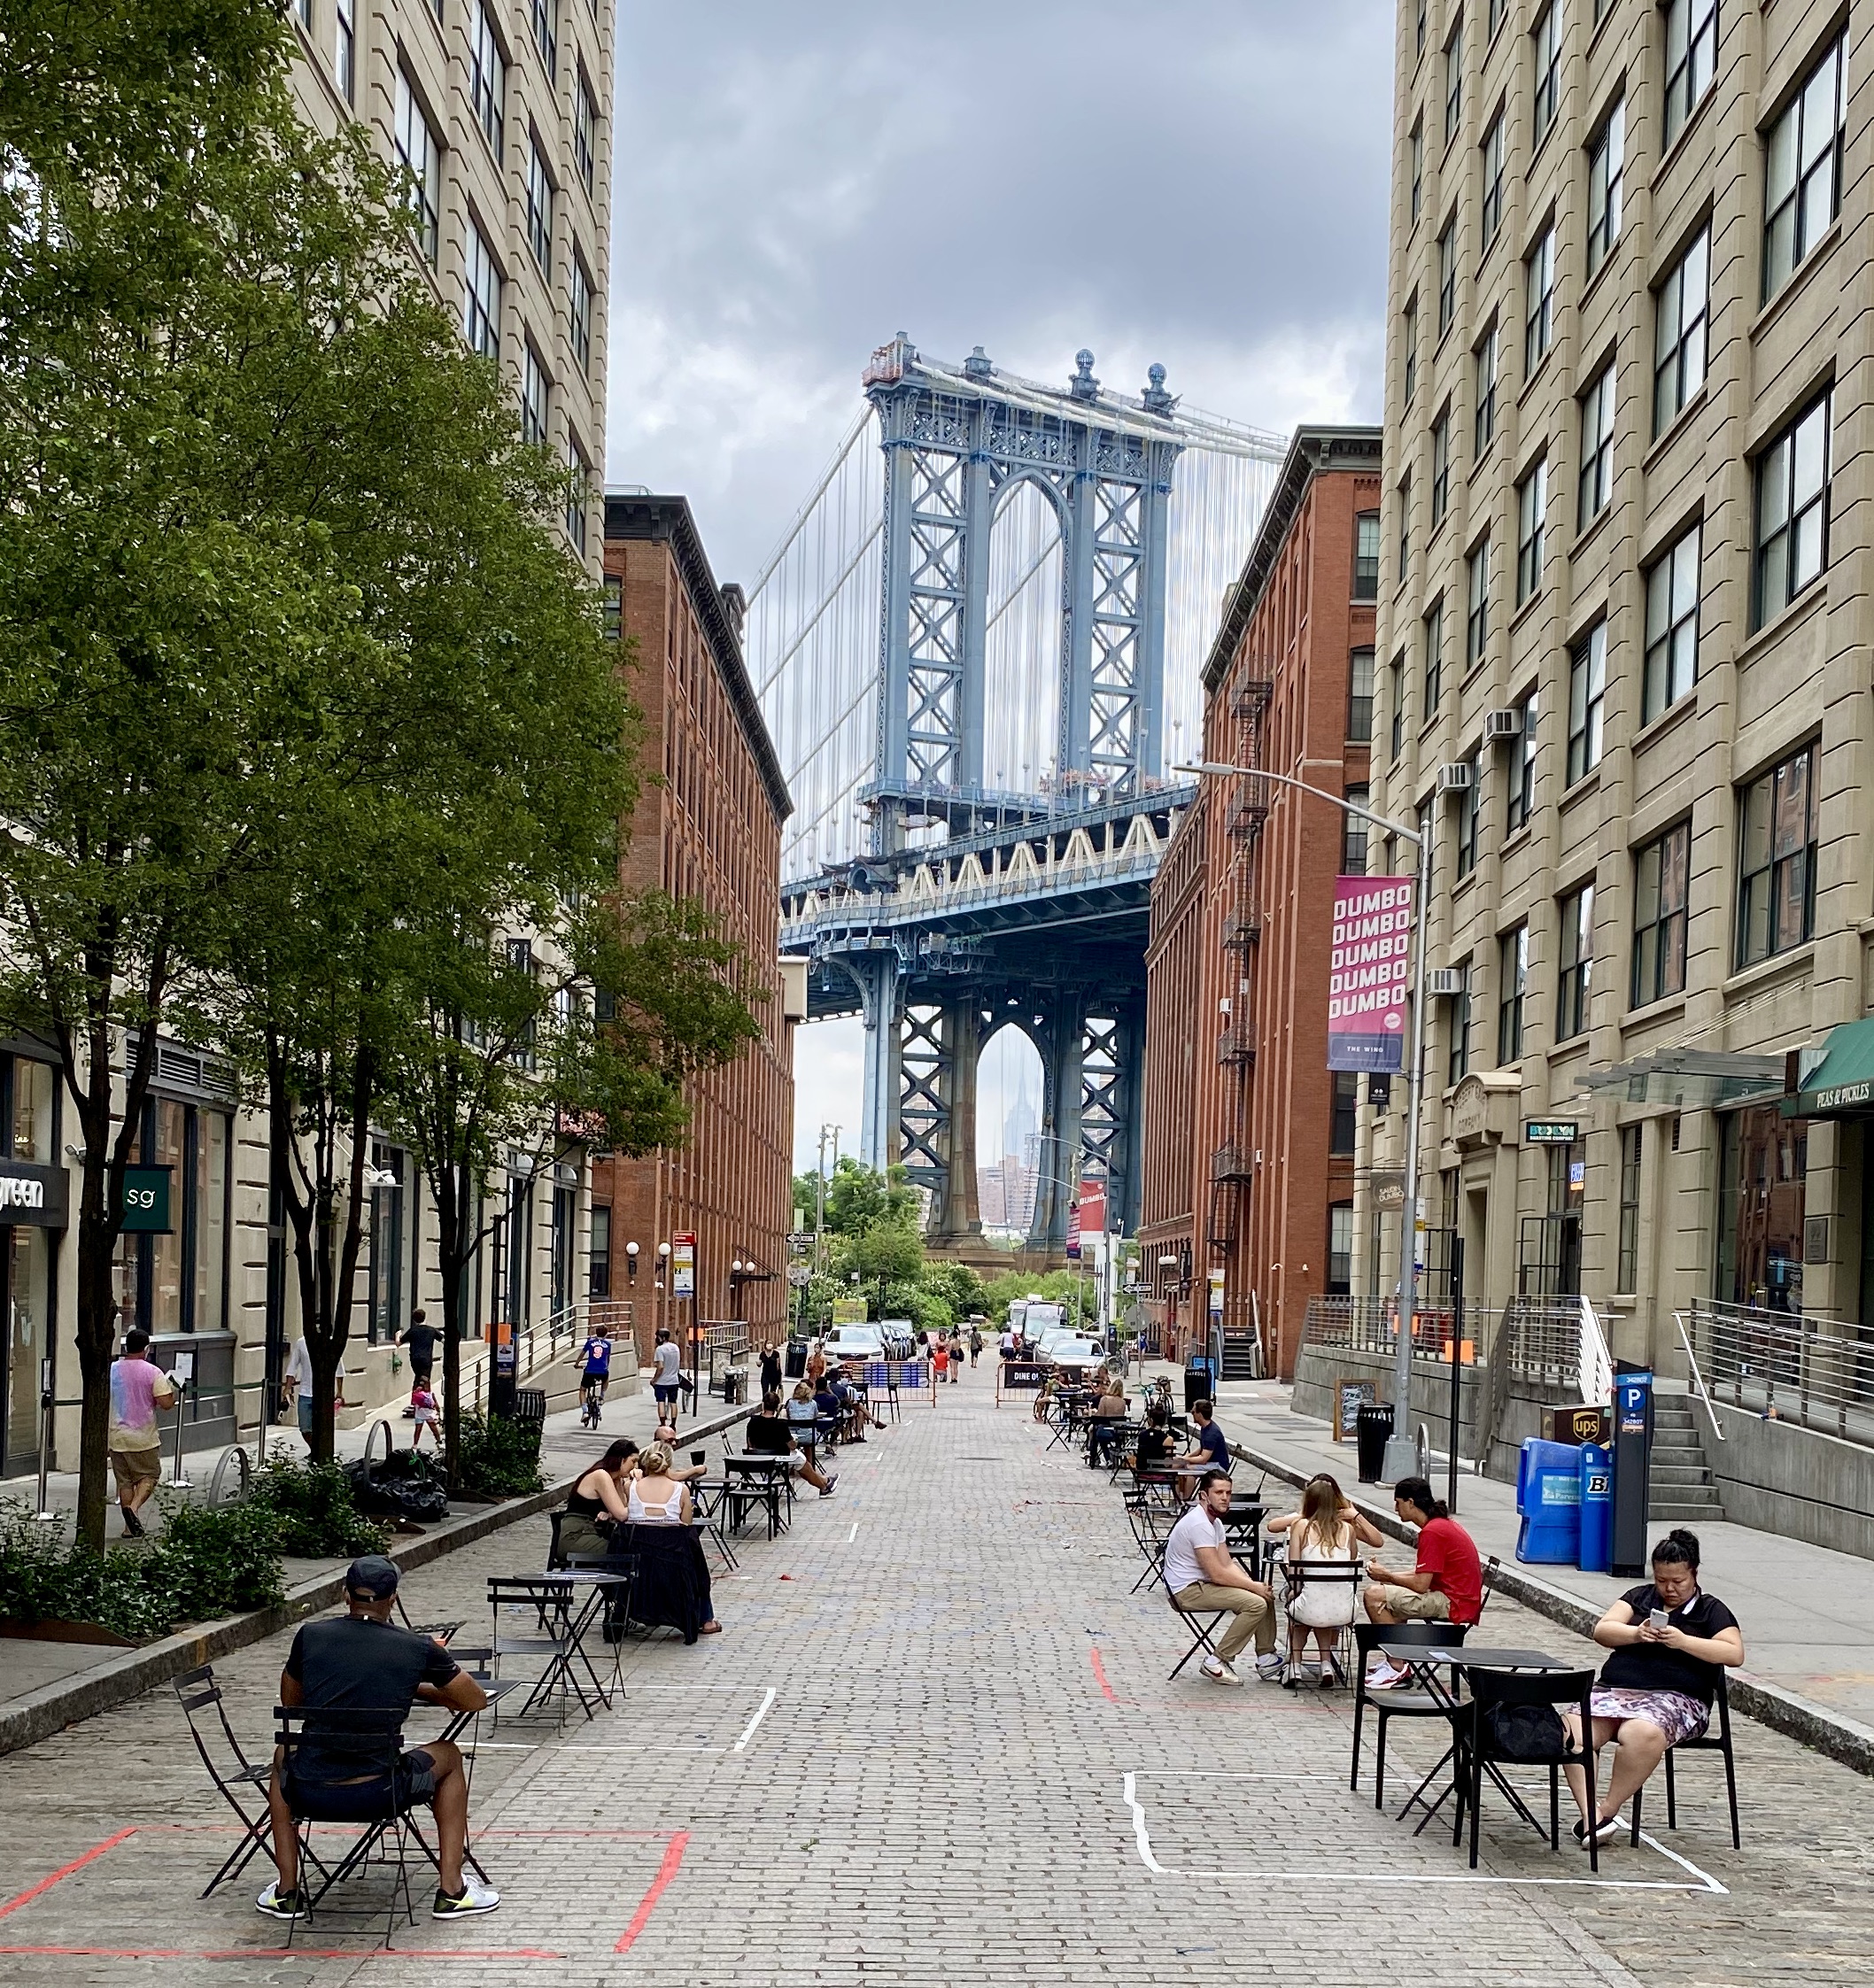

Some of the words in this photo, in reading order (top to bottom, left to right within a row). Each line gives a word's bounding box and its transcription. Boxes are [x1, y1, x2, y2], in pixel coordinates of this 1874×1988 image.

[1333, 885, 1412, 922] DUMBO
[1332, 909, 1410, 946] DUMBO
[1331, 933, 1408, 971] DUMBO
[1329, 958, 1407, 995] DUMBO
[1328, 984, 1406, 1020] DUMBO
[1816, 1090, 1834, 1109] PEAS
[1834, 1089, 1841, 1105] &
[1841, 1082, 1870, 1104] PICKLES
[127, 1189, 156, 1209] sg
[1079, 1192, 1105, 1206] DUMBO
[1378, 1190, 1406, 1203] DUMBO
[1379, 1184, 1401, 1195] SALON
[1013, 1372, 1031, 1381] DINE
[1627, 1389, 1642, 1408] P
[1576, 1420, 1598, 1437] ups
